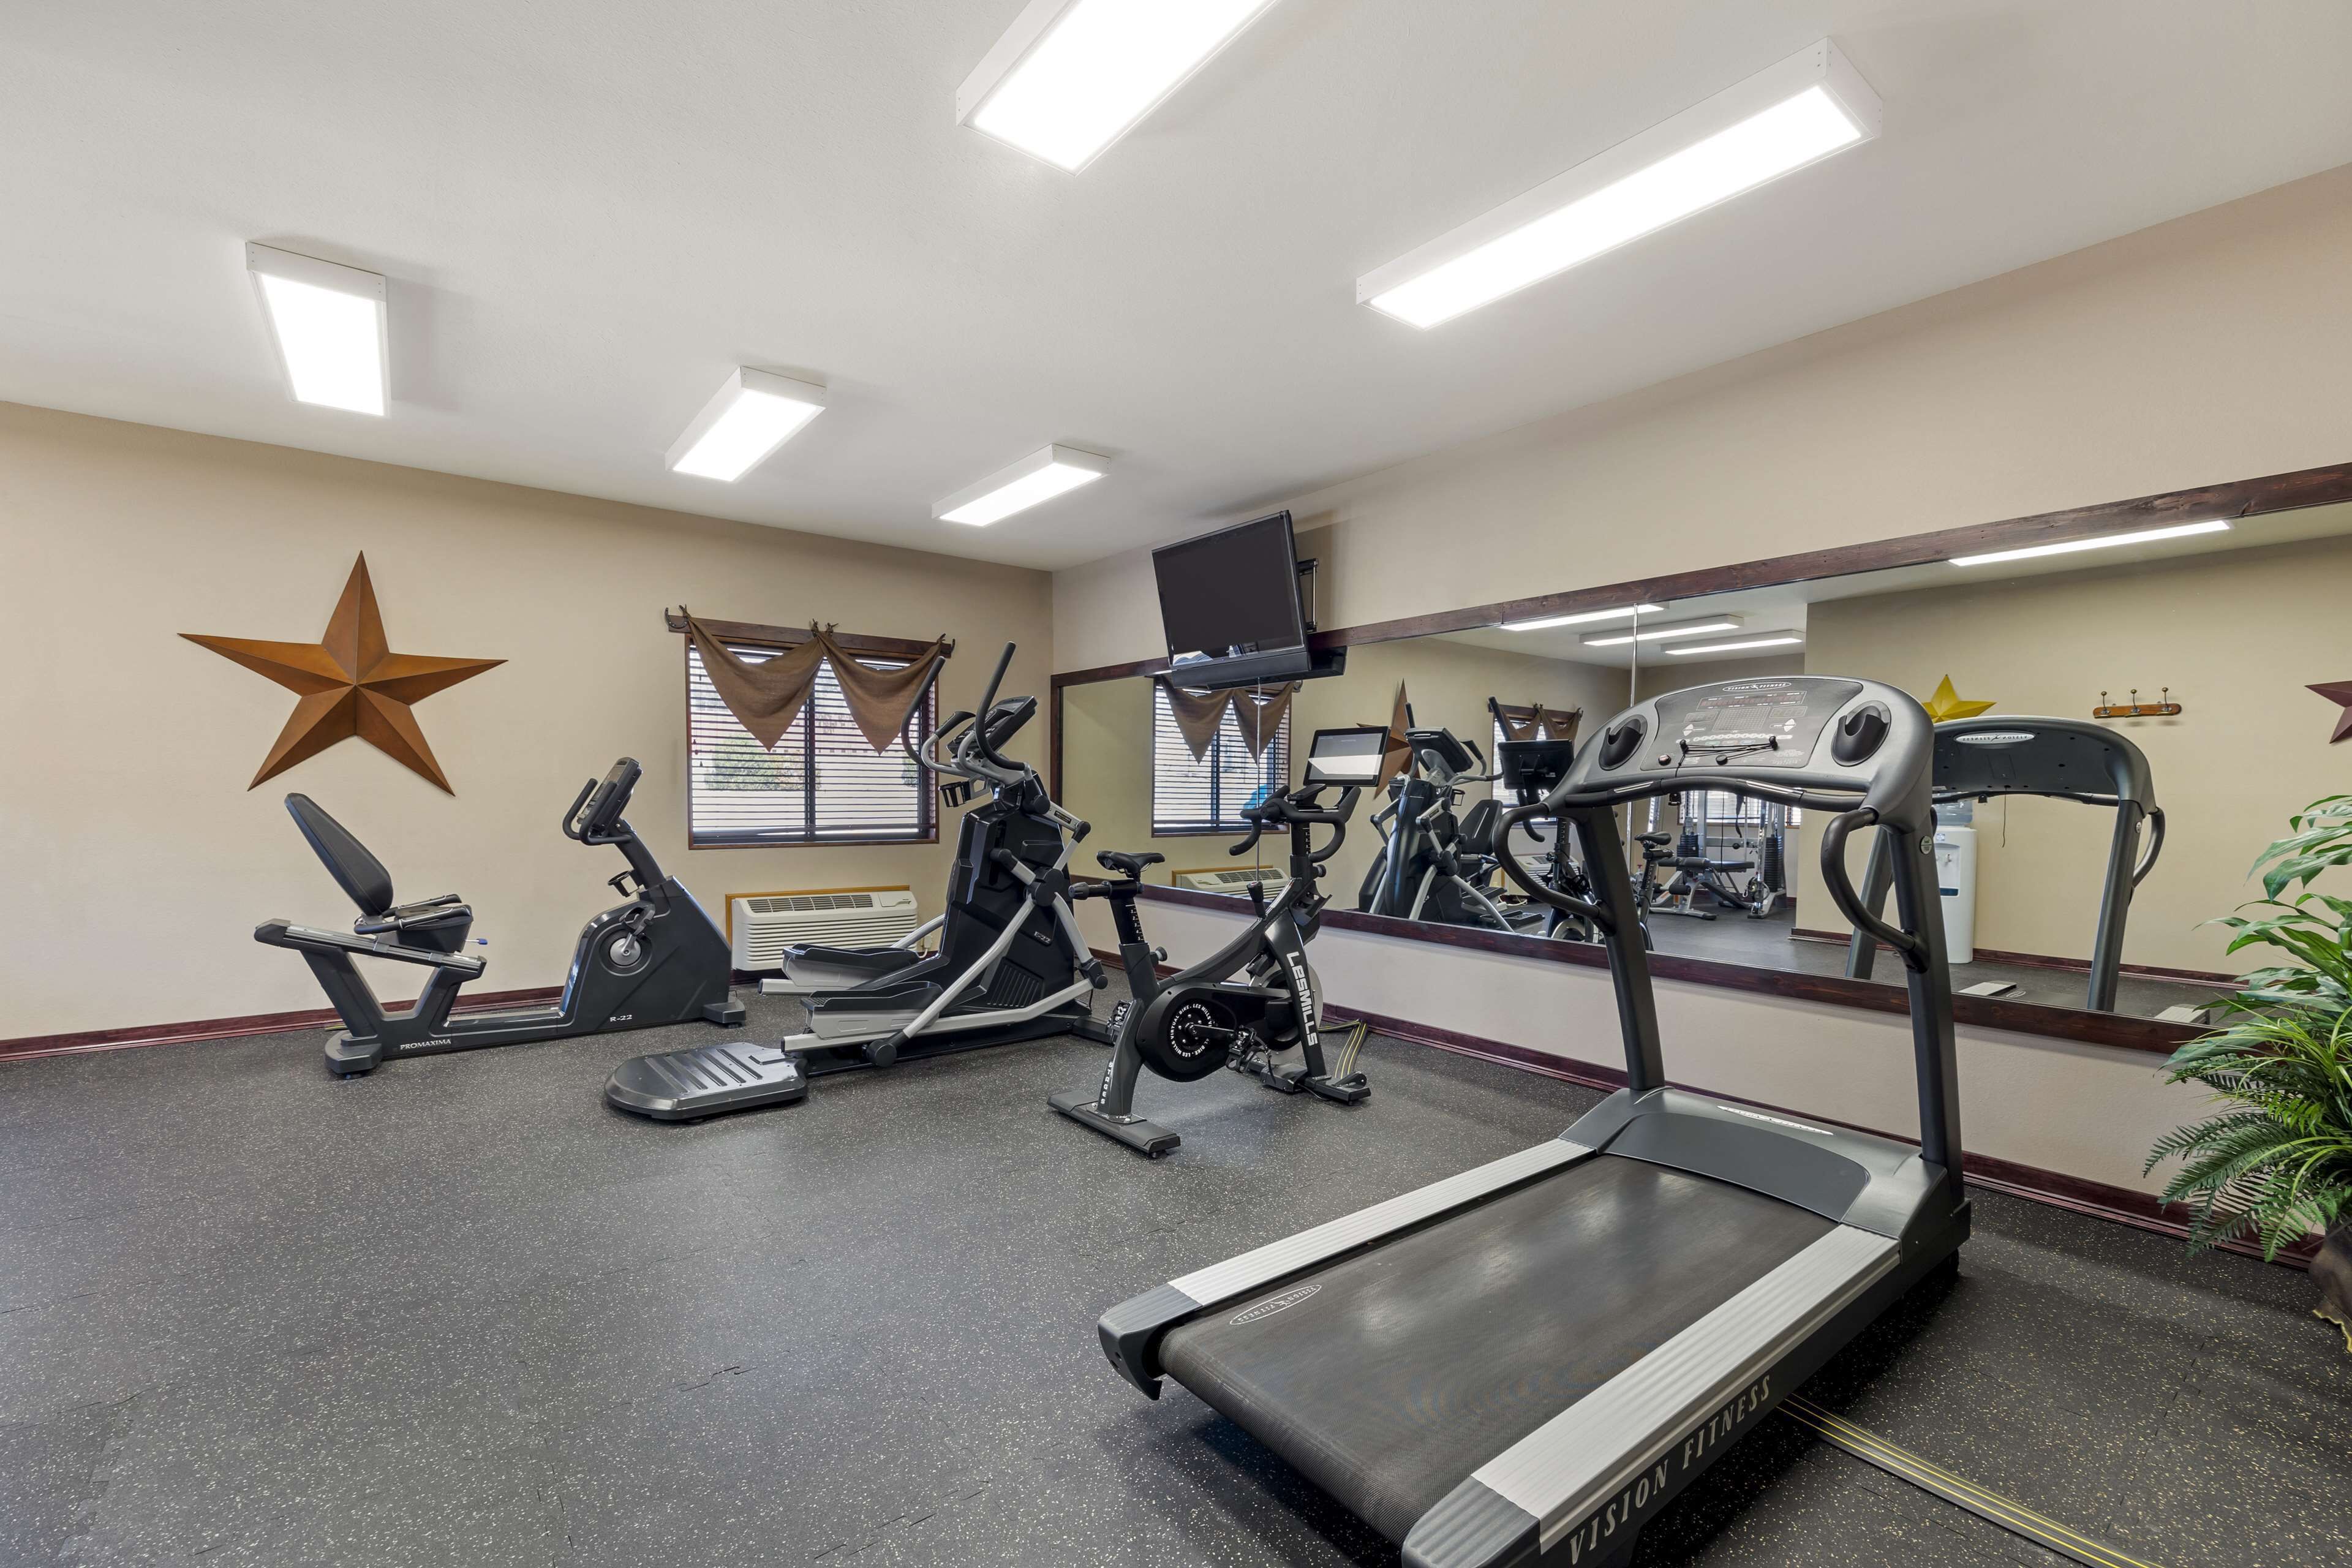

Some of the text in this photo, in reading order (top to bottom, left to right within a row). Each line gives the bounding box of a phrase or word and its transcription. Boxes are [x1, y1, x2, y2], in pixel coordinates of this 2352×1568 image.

[1178, 1005, 1190, 1015] BIKE
[1201, 1006, 1212, 1020] MILLS
[1170, 1015, 1180, 1039] VIRTUAL
[400, 1039, 451, 1050] PROMAXIMA
[1171, 1040, 1182, 1055] MILLS
[1194, 1045, 1205, 1055] BIKE
[1101, 1062, 1113, 1104] STAGES
[1570, 1375, 1770, 1565] VISION FITNESS
